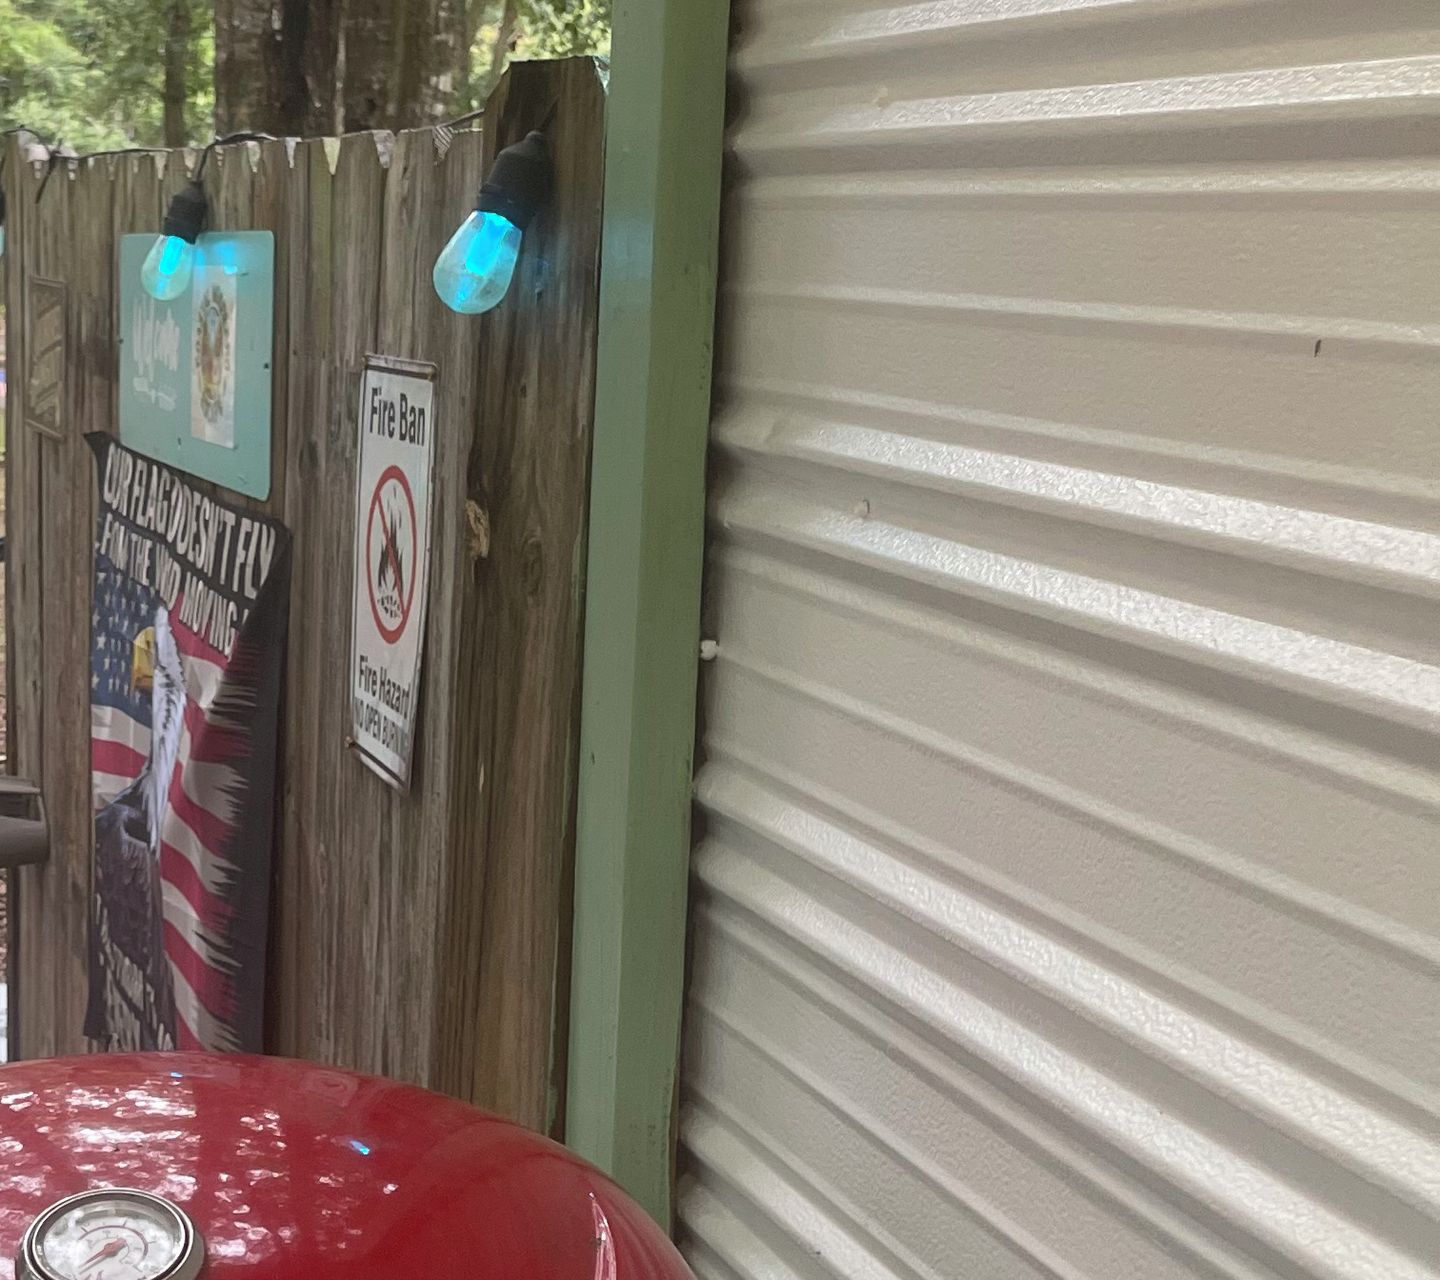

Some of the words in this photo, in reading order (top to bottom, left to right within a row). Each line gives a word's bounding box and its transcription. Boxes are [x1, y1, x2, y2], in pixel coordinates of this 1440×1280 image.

[369, 387, 396, 439] Fire
[399, 393, 425, 447] Ban
[129, 458, 172, 535] FLAG
[165, 476, 236, 585] DOESN'T
[232, 517, 276, 601] FLY
[358, 655, 378, 697] Fire
[378, 666, 411, 720] Hazard
